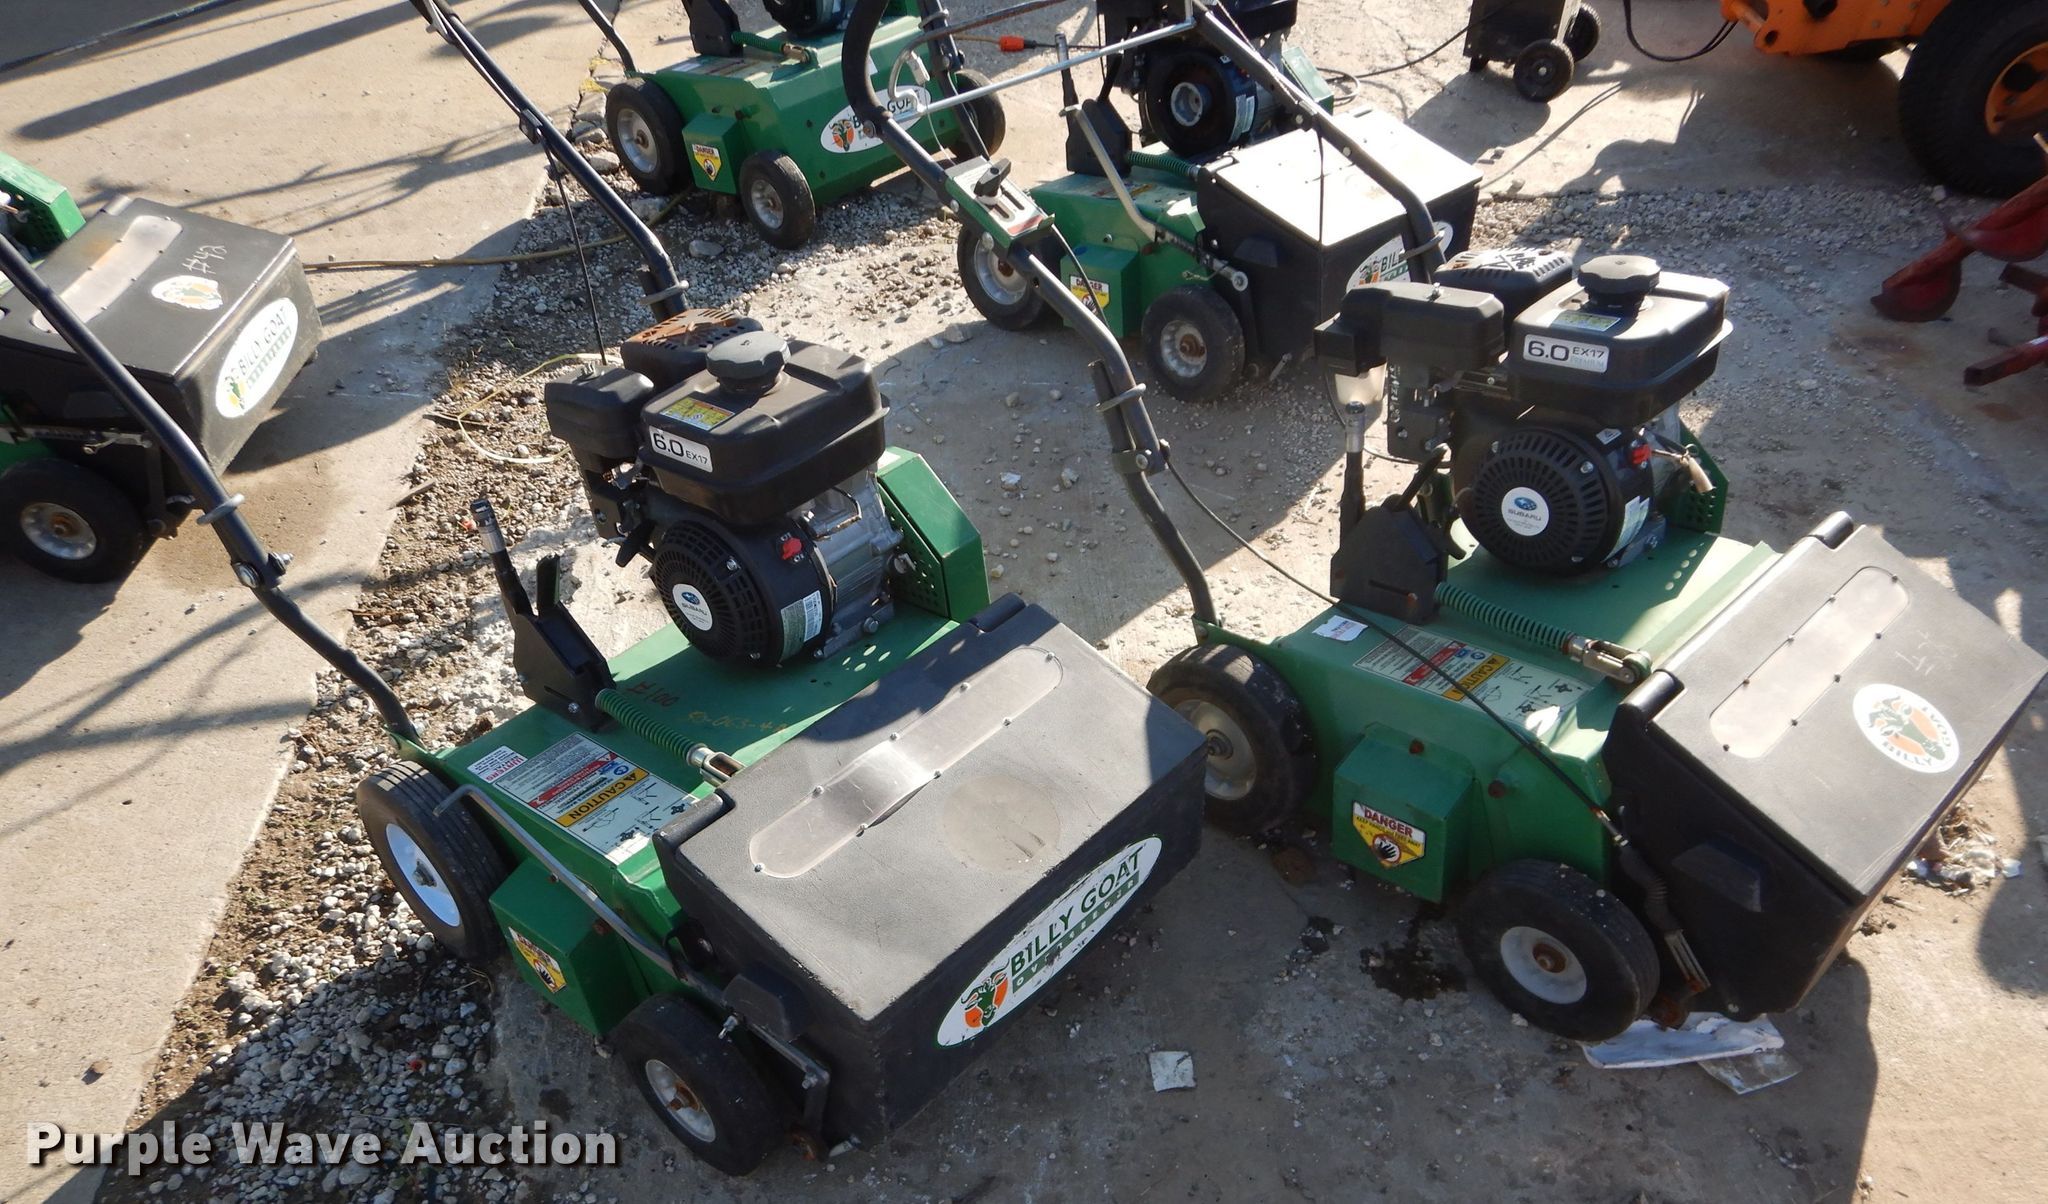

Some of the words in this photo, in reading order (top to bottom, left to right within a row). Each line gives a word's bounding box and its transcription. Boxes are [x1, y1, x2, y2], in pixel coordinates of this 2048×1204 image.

[1528, 340, 1570, 361] 6.0
[1573, 346, 1604, 358] EX17
[653, 433, 684, 457] 6.0
[686, 450, 708, 464] EX17
[1508, 508, 1541, 521] SUBARU
[681, 602, 707, 616] SUBARU
[1881, 740, 1933, 767] BILLY
[569, 781, 626, 820] CAUTION
[1364, 807, 1413, 838] DANGER
[1011, 906, 1074, 977] BILLY
[1080, 845, 1144, 914] GOAT
